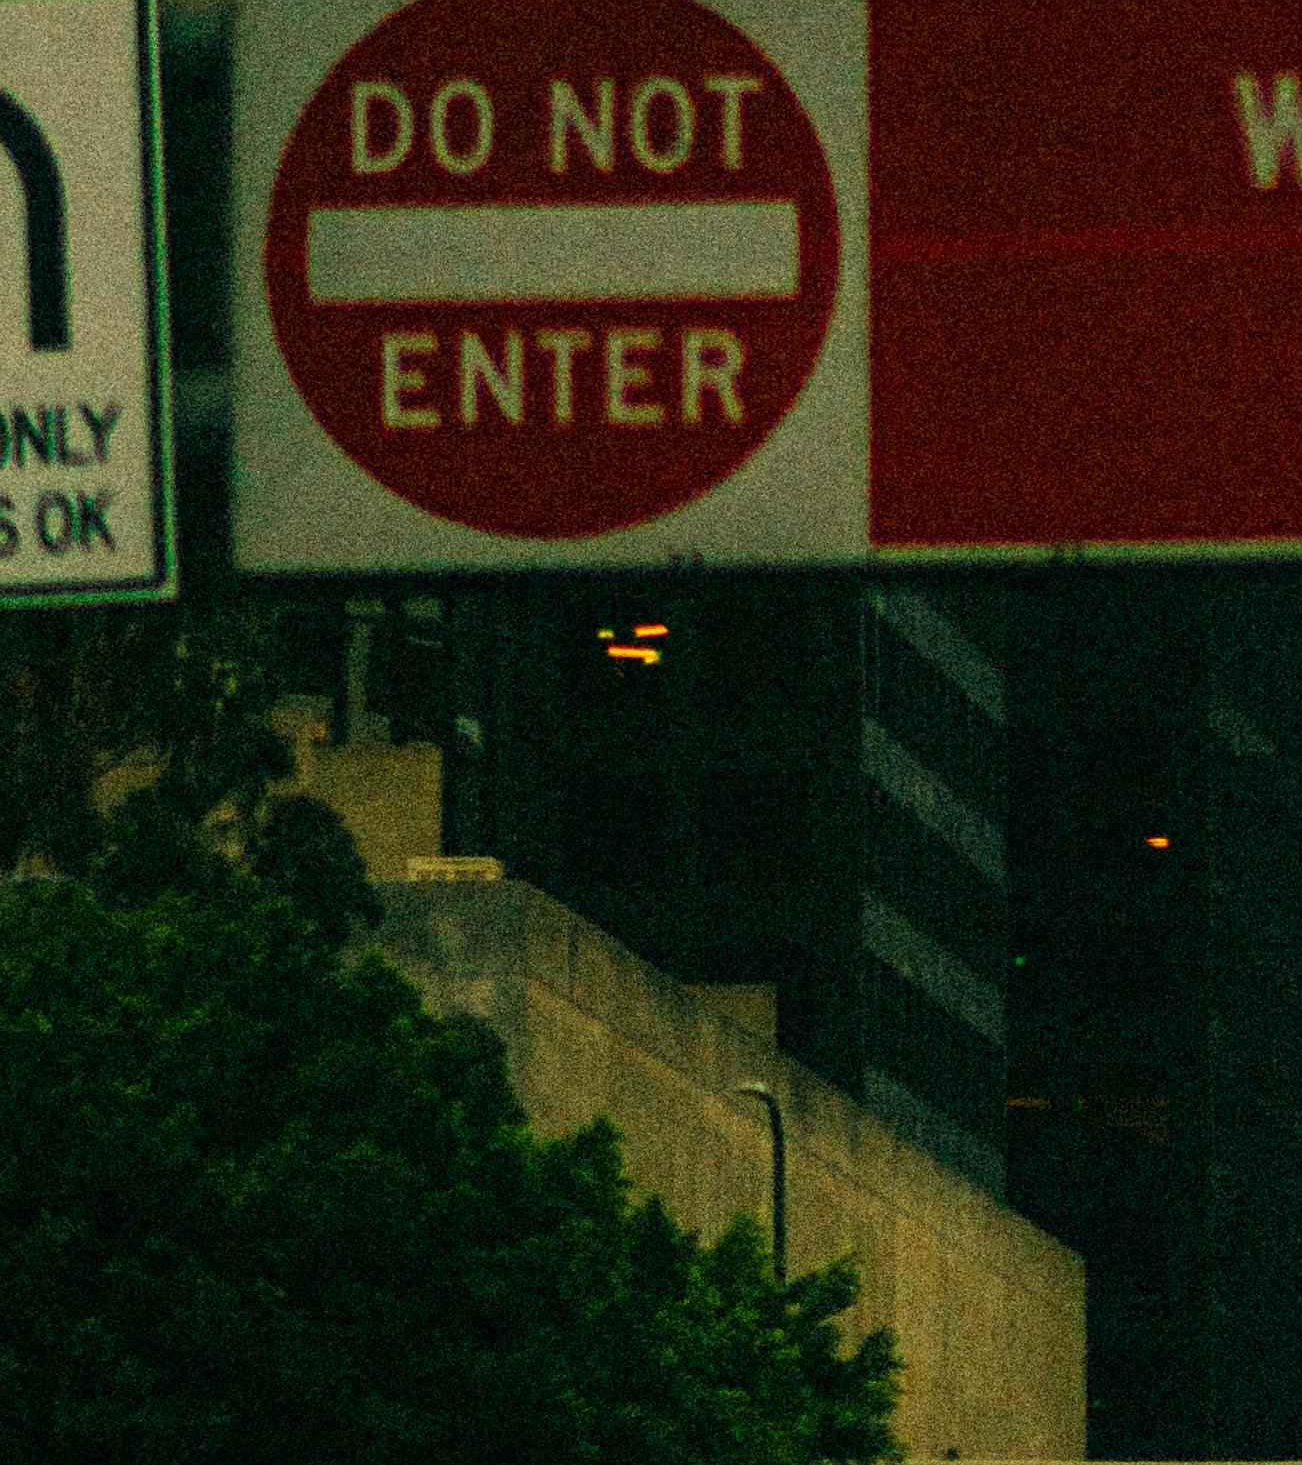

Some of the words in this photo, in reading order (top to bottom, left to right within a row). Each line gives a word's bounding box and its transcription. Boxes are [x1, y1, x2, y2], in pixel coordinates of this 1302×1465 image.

[352, 79, 494, 176] DO
[550, 76, 763, 174] NOT
[381, 328, 745, 429] ENTER
[0, 401, 121, 467] NLY
[35, 490, 115, 555] OK
